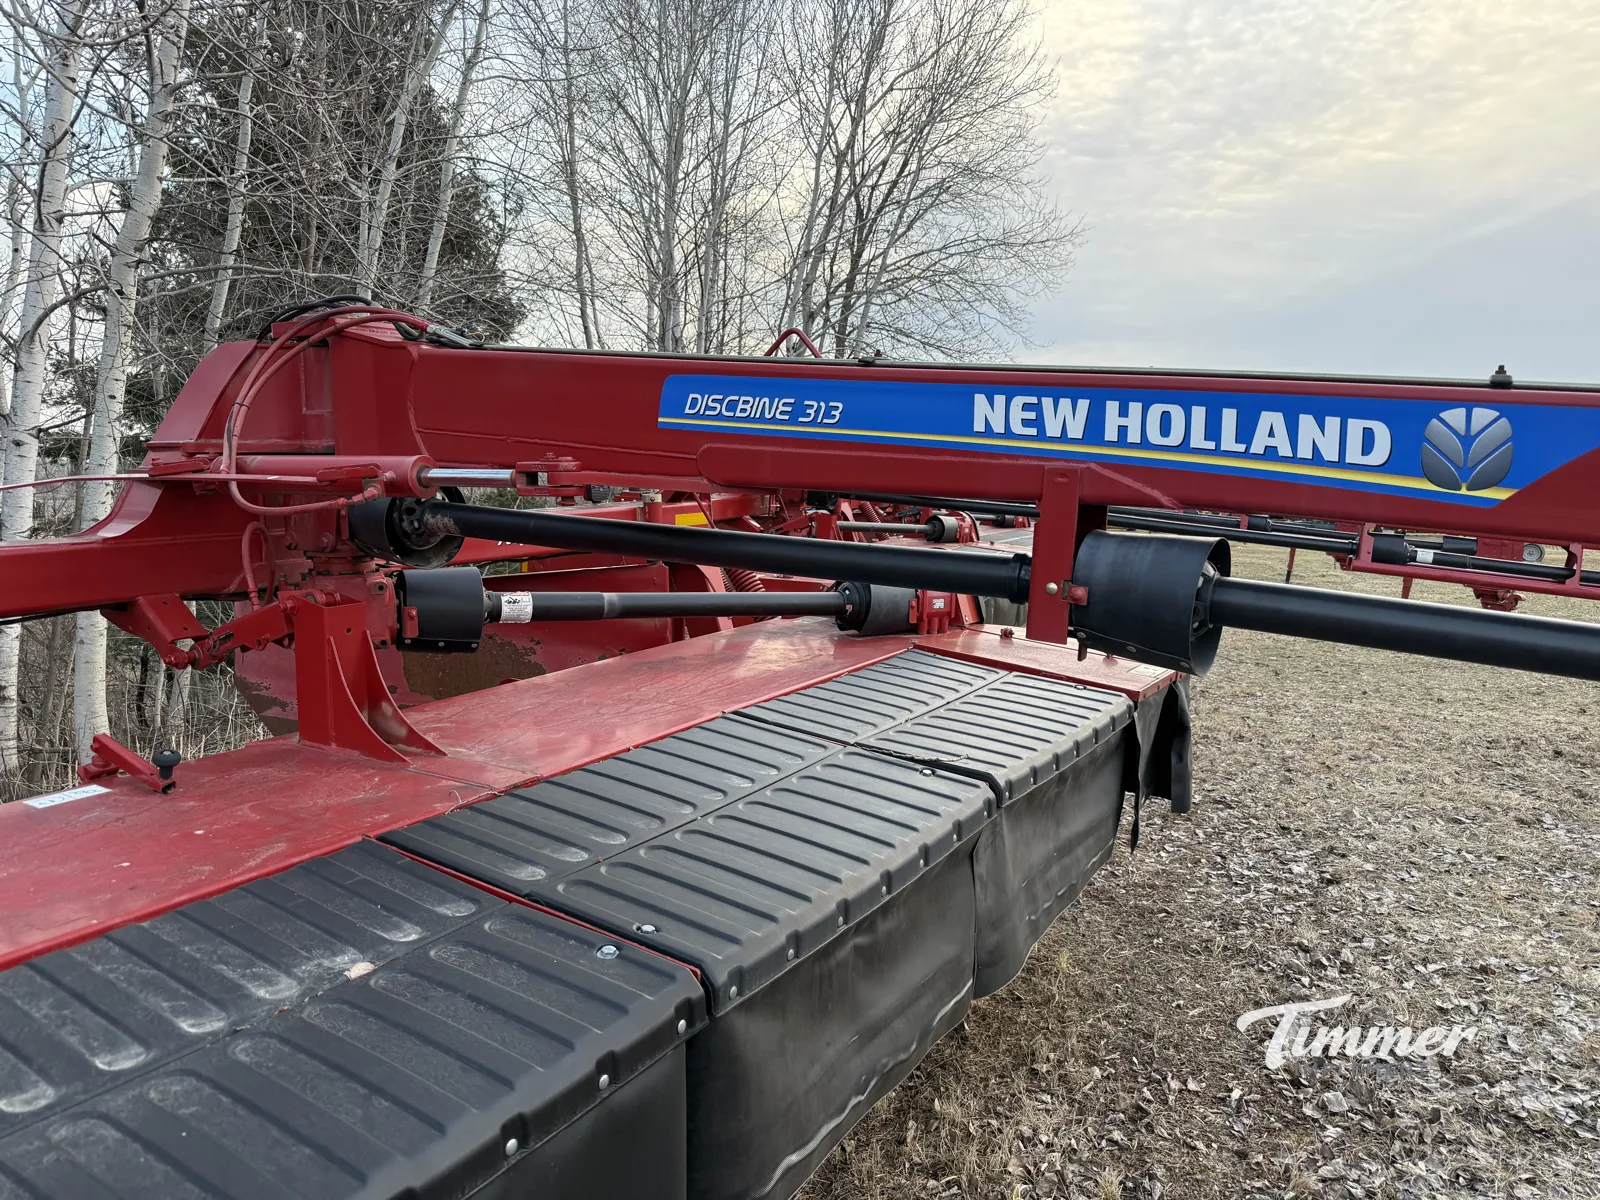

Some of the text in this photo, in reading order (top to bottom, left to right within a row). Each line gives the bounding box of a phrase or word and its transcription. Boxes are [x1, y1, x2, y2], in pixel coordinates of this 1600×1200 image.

[684, 393, 844, 424] DISCBINE 313
[973, 393, 1393, 467] NEW HOLLAND
